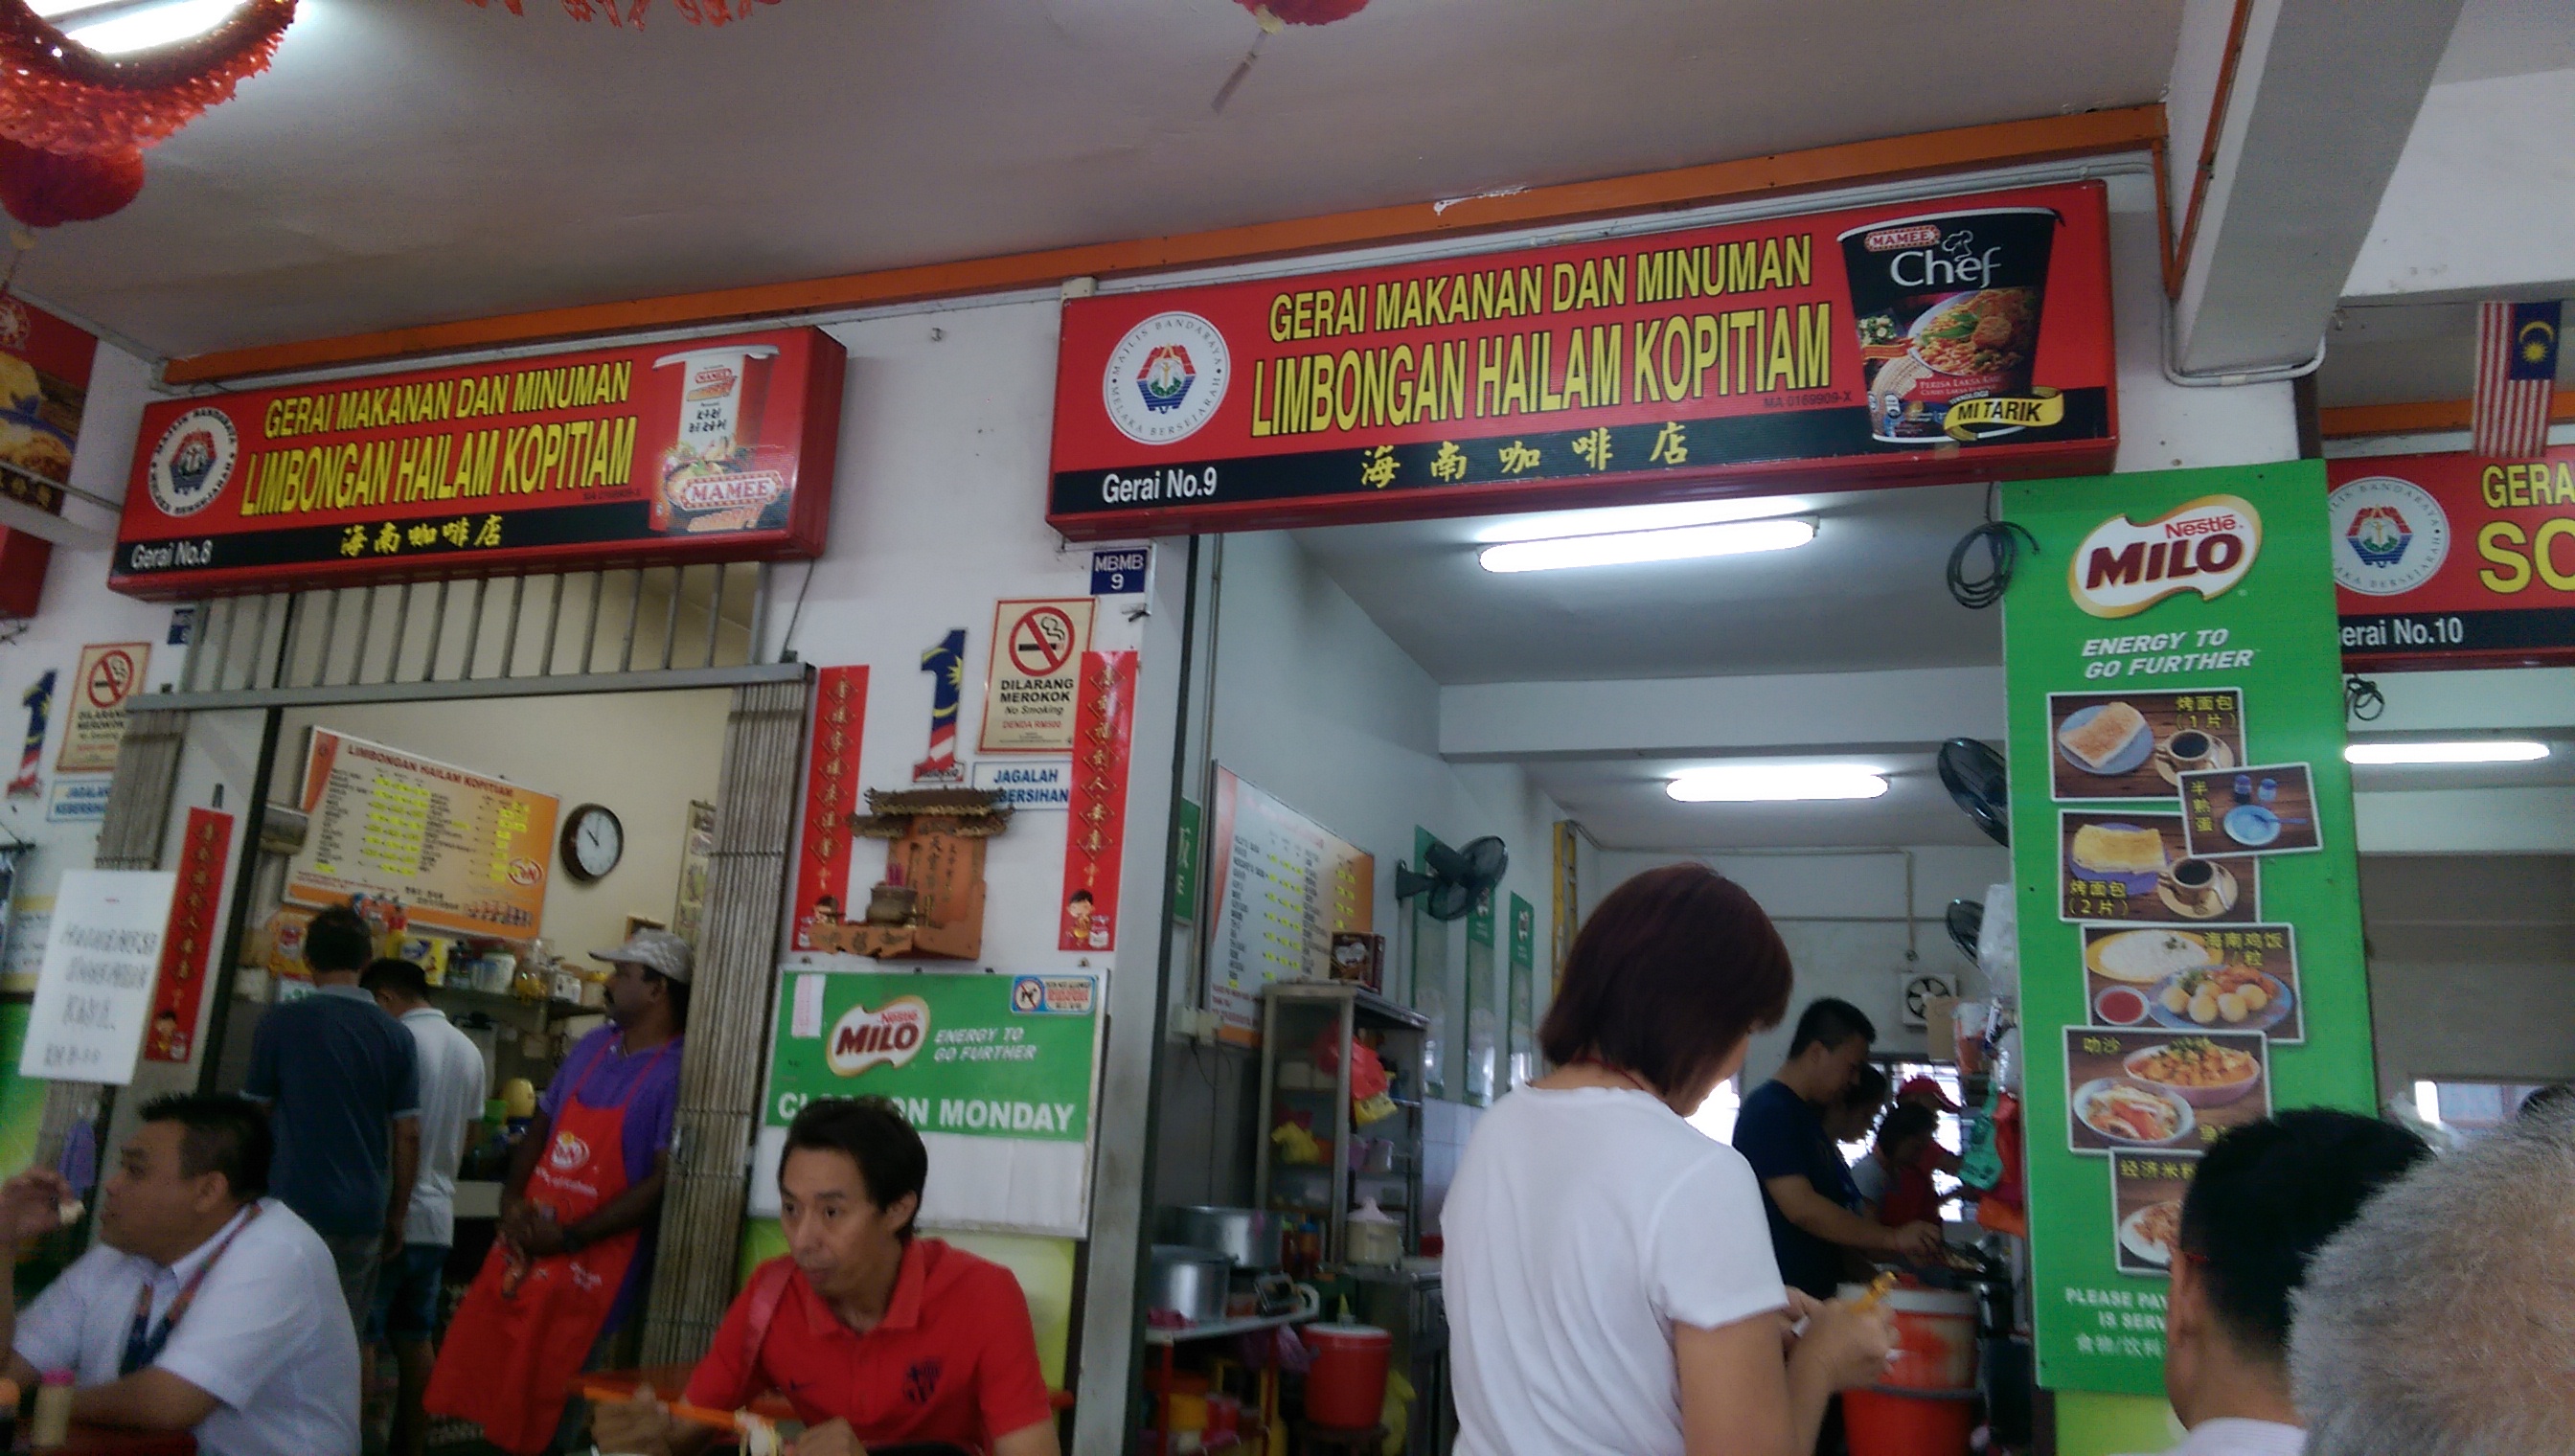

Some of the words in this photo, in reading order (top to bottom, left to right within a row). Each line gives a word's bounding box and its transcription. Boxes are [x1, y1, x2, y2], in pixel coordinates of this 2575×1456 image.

[1872, 231, 1930, 247] MAMEE
[1890, 246, 2002, 289] Chef
[1268, 285, 1367, 343] GERAI
[1374, 264, 1544, 331] MAKANAN
[1552, 255, 1628, 313] DAN
[1635, 234, 1812, 304] MINUMAN
[1154, 319, 1222, 365] BANDARAYA
[1250, 339, 1468, 438] LIMBONGAN
[1475, 323, 1624, 418] HAILAM
[1632, 301, 1832, 404] KOPITIAM
[263, 394, 335, 440] GERAI
[335, 380, 454, 431] MAKANAN
[455, 373, 511, 419] DAN
[512, 360, 633, 413] MINUMAN
[1111, 386, 1143, 433] MELAKA
[1957, 405, 1978, 421] MI
[1983, 400, 2043, 421] TARIK
[240, 440, 396, 516] LIMBONGAN
[393, 429, 501, 504] HAILAM
[499, 416, 638, 494] KOPITIAM
[1361, 421, 1689, 489] 海南咖啡店
[692, 480, 770, 501] MAMEE
[1103, 470, 1161, 504] Gerai
[1167, 466, 1218, 498] No.9
[340, 514, 504, 557] 海南咖啡店
[130, 543, 173, 570] Gerai
[173, 538, 213, 566] No.8
[1094, 553, 1144, 573] MBMB
[2085, 533, 2245, 590] MILO
[1110, 574, 1124, 590] 9
[2082, 631, 2187, 657] ENERGY
[2197, 627, 2230, 648] TO
[2340, 618, 2388, 648] erai
[2393, 617, 2464, 645] No.10
[2085, 660, 2121, 681] GO
[2127, 649, 2255, 676] FURTHER
[999, 691, 1071, 703] MEROKOK
[1000, 678, 1074, 691] DILARANG
[1002, 720, 1033, 729] DENDA
[1006, 705, 1018, 716] No
[1021, 705, 1064, 717] Smoking
[993, 768, 1059, 784] JAGALAH
[835, 1022, 920, 1056] MILO
[934, 1027, 999, 1044] ENERGY
[1002, 1026, 1025, 1041] TO
[933, 1047, 955, 1063] GO
[958, 1045, 1038, 1060] FURTHER
[939, 1099, 1075, 1132] MONDAY
[2065, 1286, 2133, 1308] PLEASE
[2099, 1310, 2117, 1329] IS
